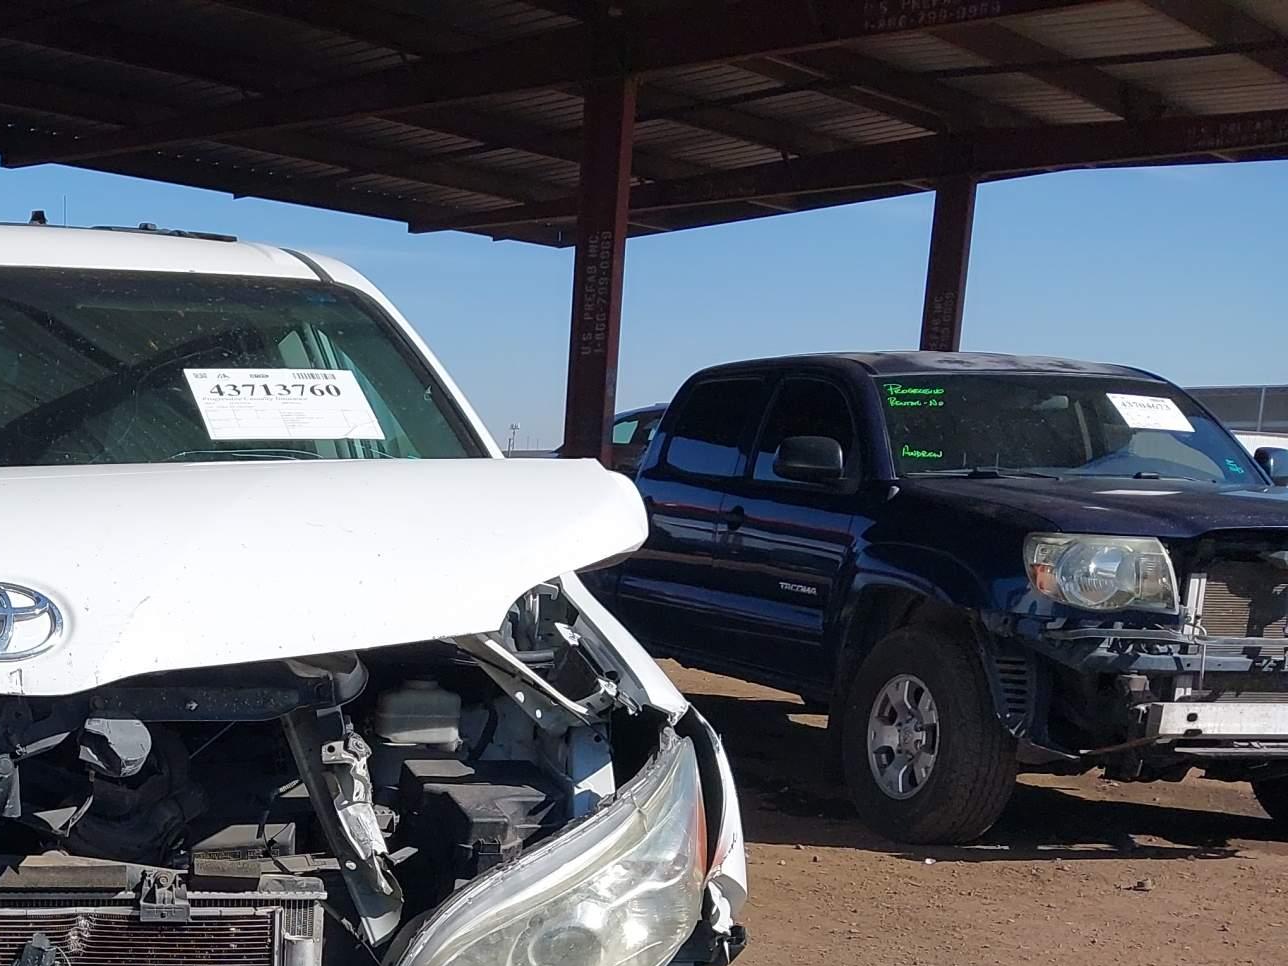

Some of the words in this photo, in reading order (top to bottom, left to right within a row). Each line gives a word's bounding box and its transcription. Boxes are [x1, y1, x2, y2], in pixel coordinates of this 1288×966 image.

[583, 265, 598, 320] PREFAB
[209, 384, 341, 397] 43713760
[778, 582, 818, 595] TACOMA
